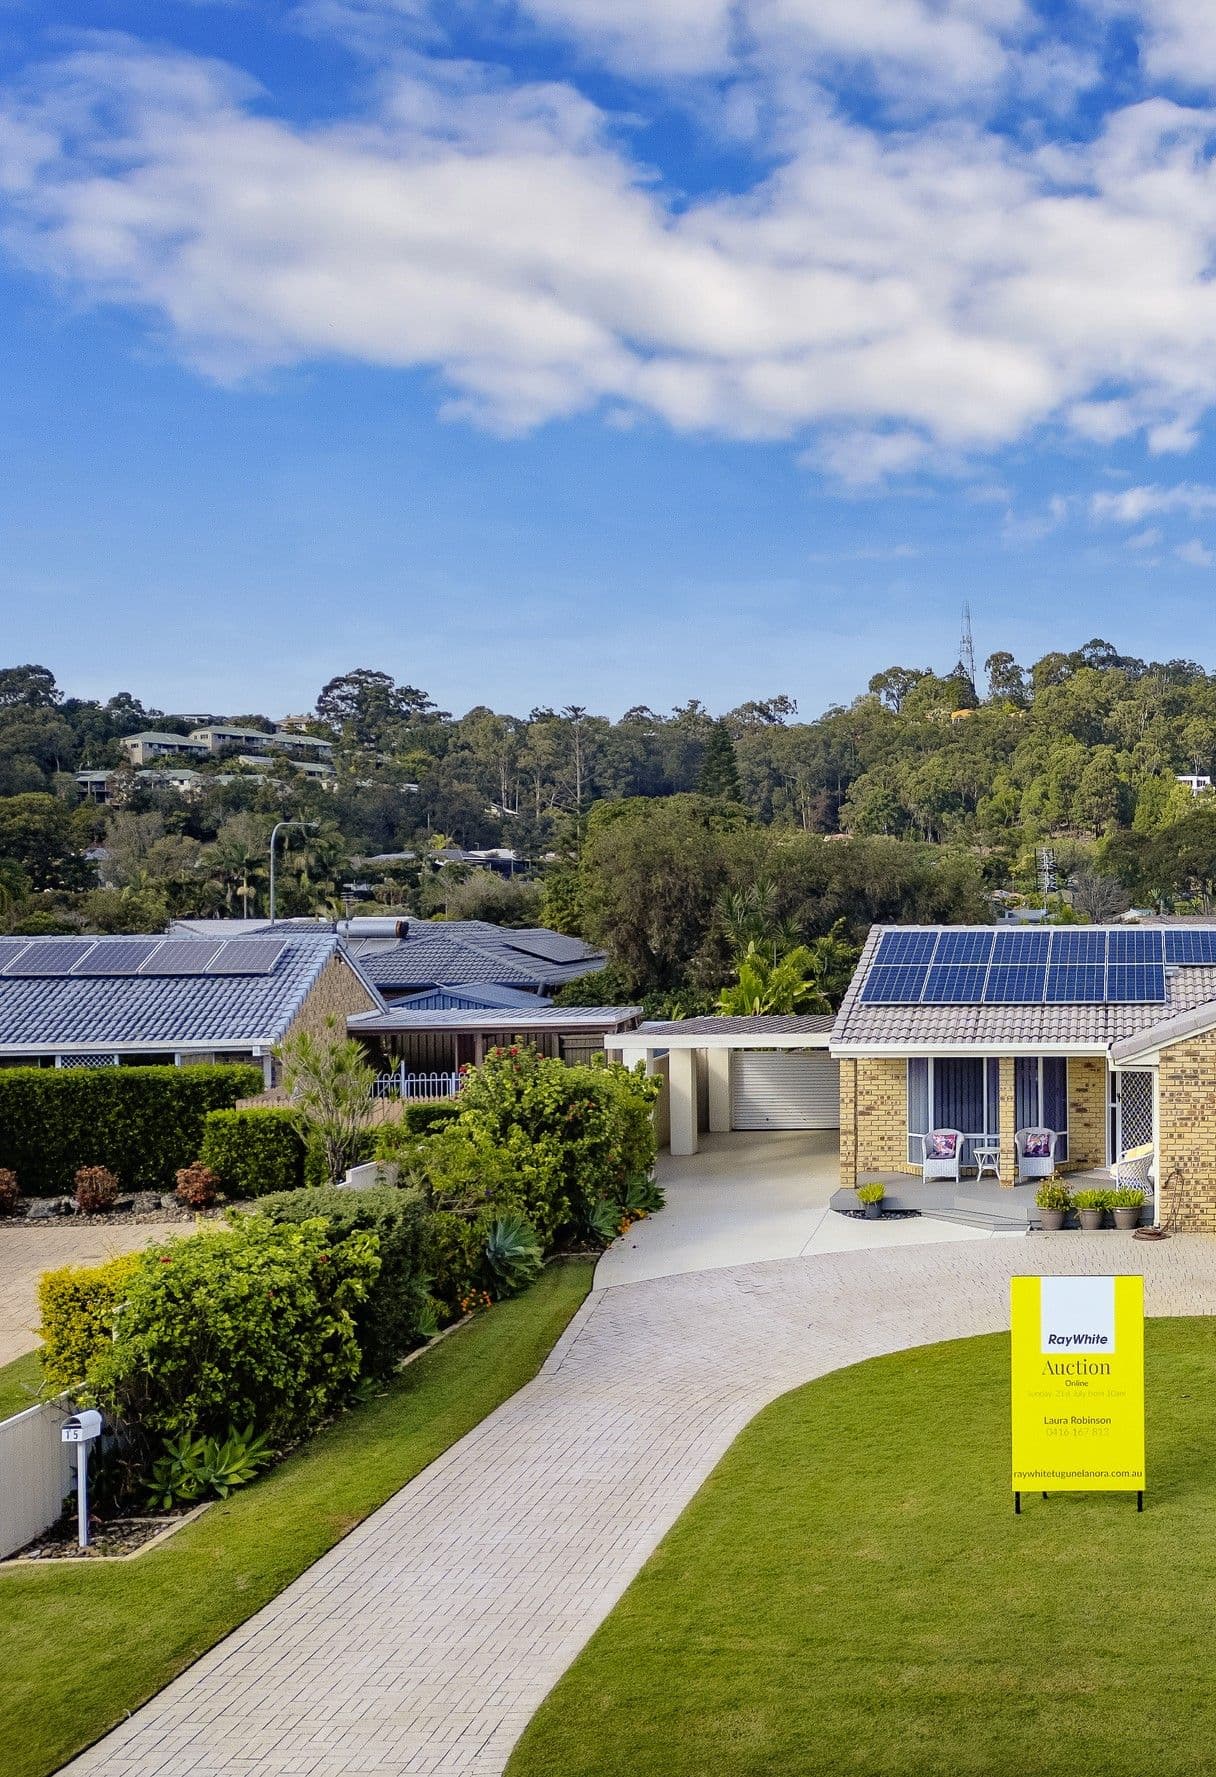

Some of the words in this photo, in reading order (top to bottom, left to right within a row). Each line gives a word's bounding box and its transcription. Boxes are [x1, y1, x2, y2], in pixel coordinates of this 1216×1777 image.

[1042, 1359, 1111, 1376] Auction
[1065, 1379, 1089, 1387] Online
[1043, 1416, 1068, 1425] Laura
[1070, 1416, 1111, 1425] Robinson
[1013, 1468, 1143, 1480] raywhitetugunelanora.com.au
